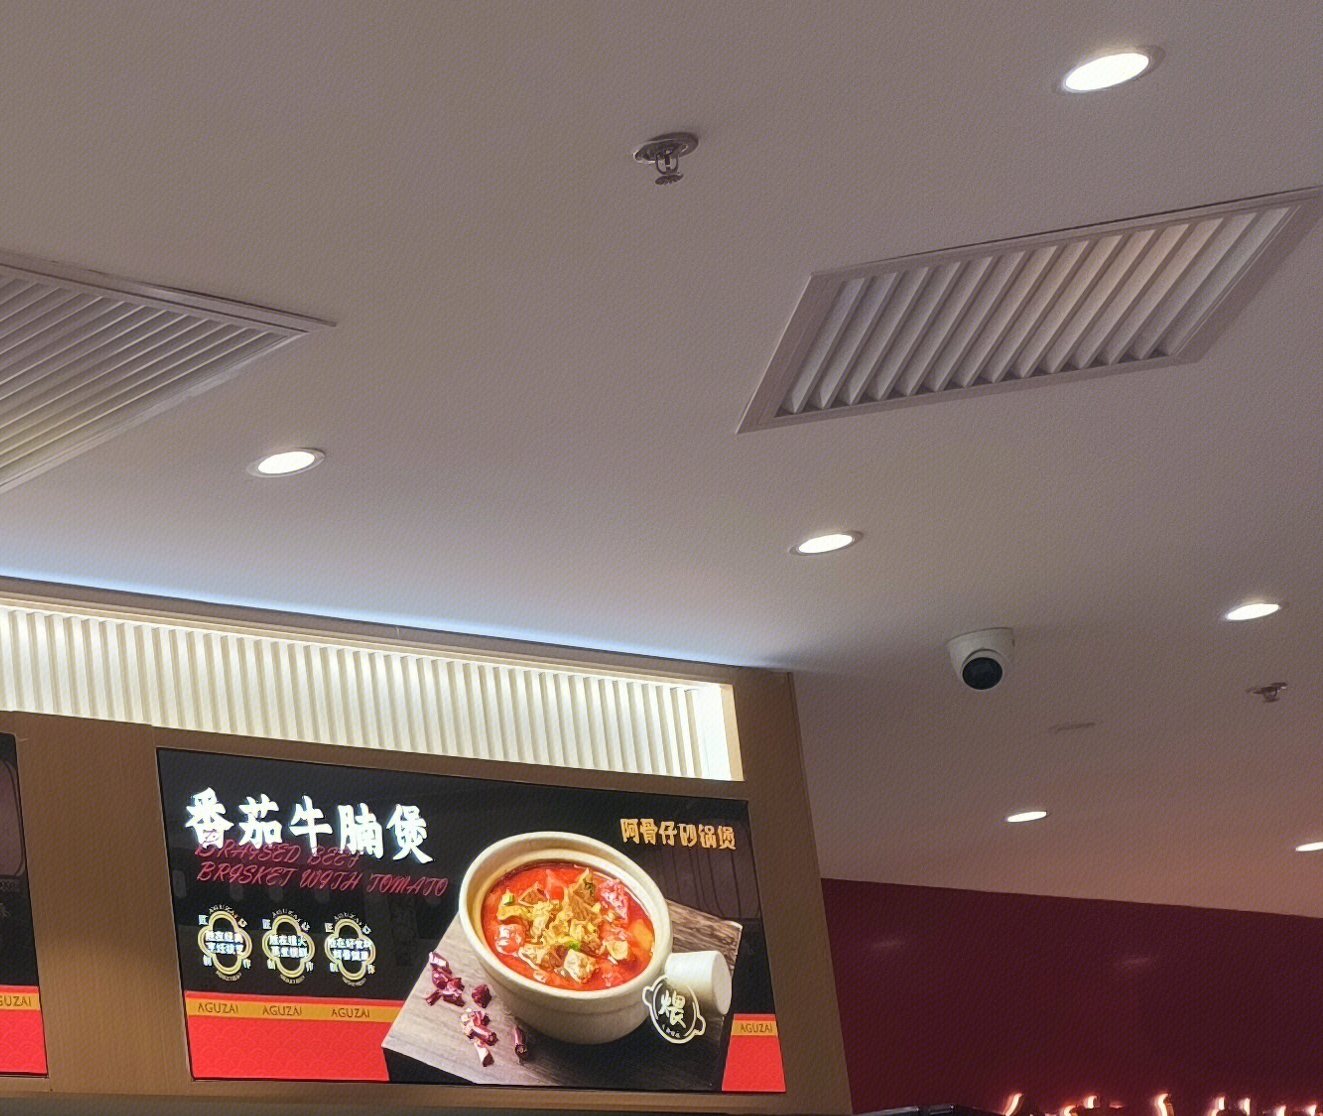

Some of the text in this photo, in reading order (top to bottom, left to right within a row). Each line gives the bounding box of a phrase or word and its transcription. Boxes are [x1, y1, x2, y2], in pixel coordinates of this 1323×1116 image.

[185, 786, 434, 864] 番茄牛腩煲
[620, 818, 736, 850] 阿骨仔砂锅煲
[196, 861, 449, 897] BRISKET WITH TOMATO
[198, 1002, 371, 1018] AGUZAI AGUZAI AGUZAI
[739, 1022, 774, 1034] AGUZAI
